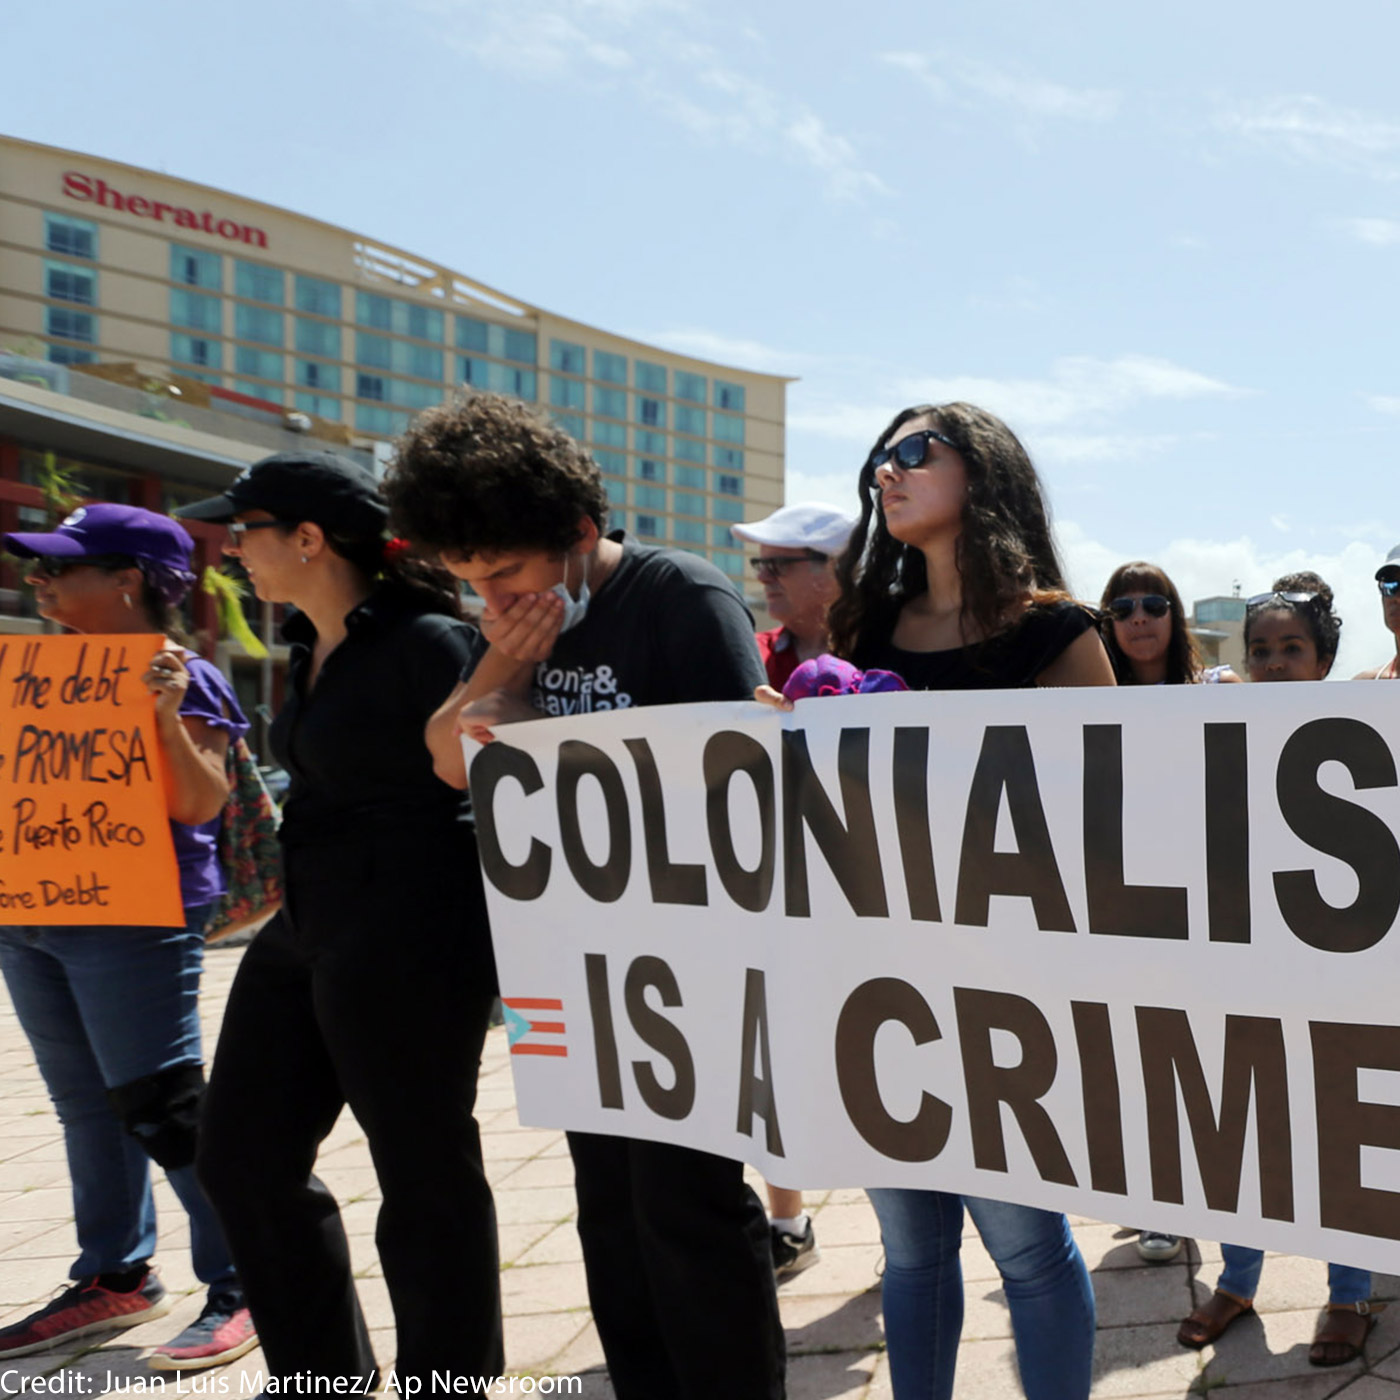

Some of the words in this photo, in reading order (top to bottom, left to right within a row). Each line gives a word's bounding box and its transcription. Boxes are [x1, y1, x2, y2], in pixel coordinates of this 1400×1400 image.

[62, 170, 269, 249] Sheraton
[12, 641, 52, 709] the
[60, 641, 129, 706] debt
[13, 724, 151, 786] PROMESA
[13, 797, 81, 855] Puerto
[82, 800, 145, 847] Rico
[37, 871, 110, 907] Debt
[584, 953, 696, 1121] IS
[736, 967, 786, 1158] A
